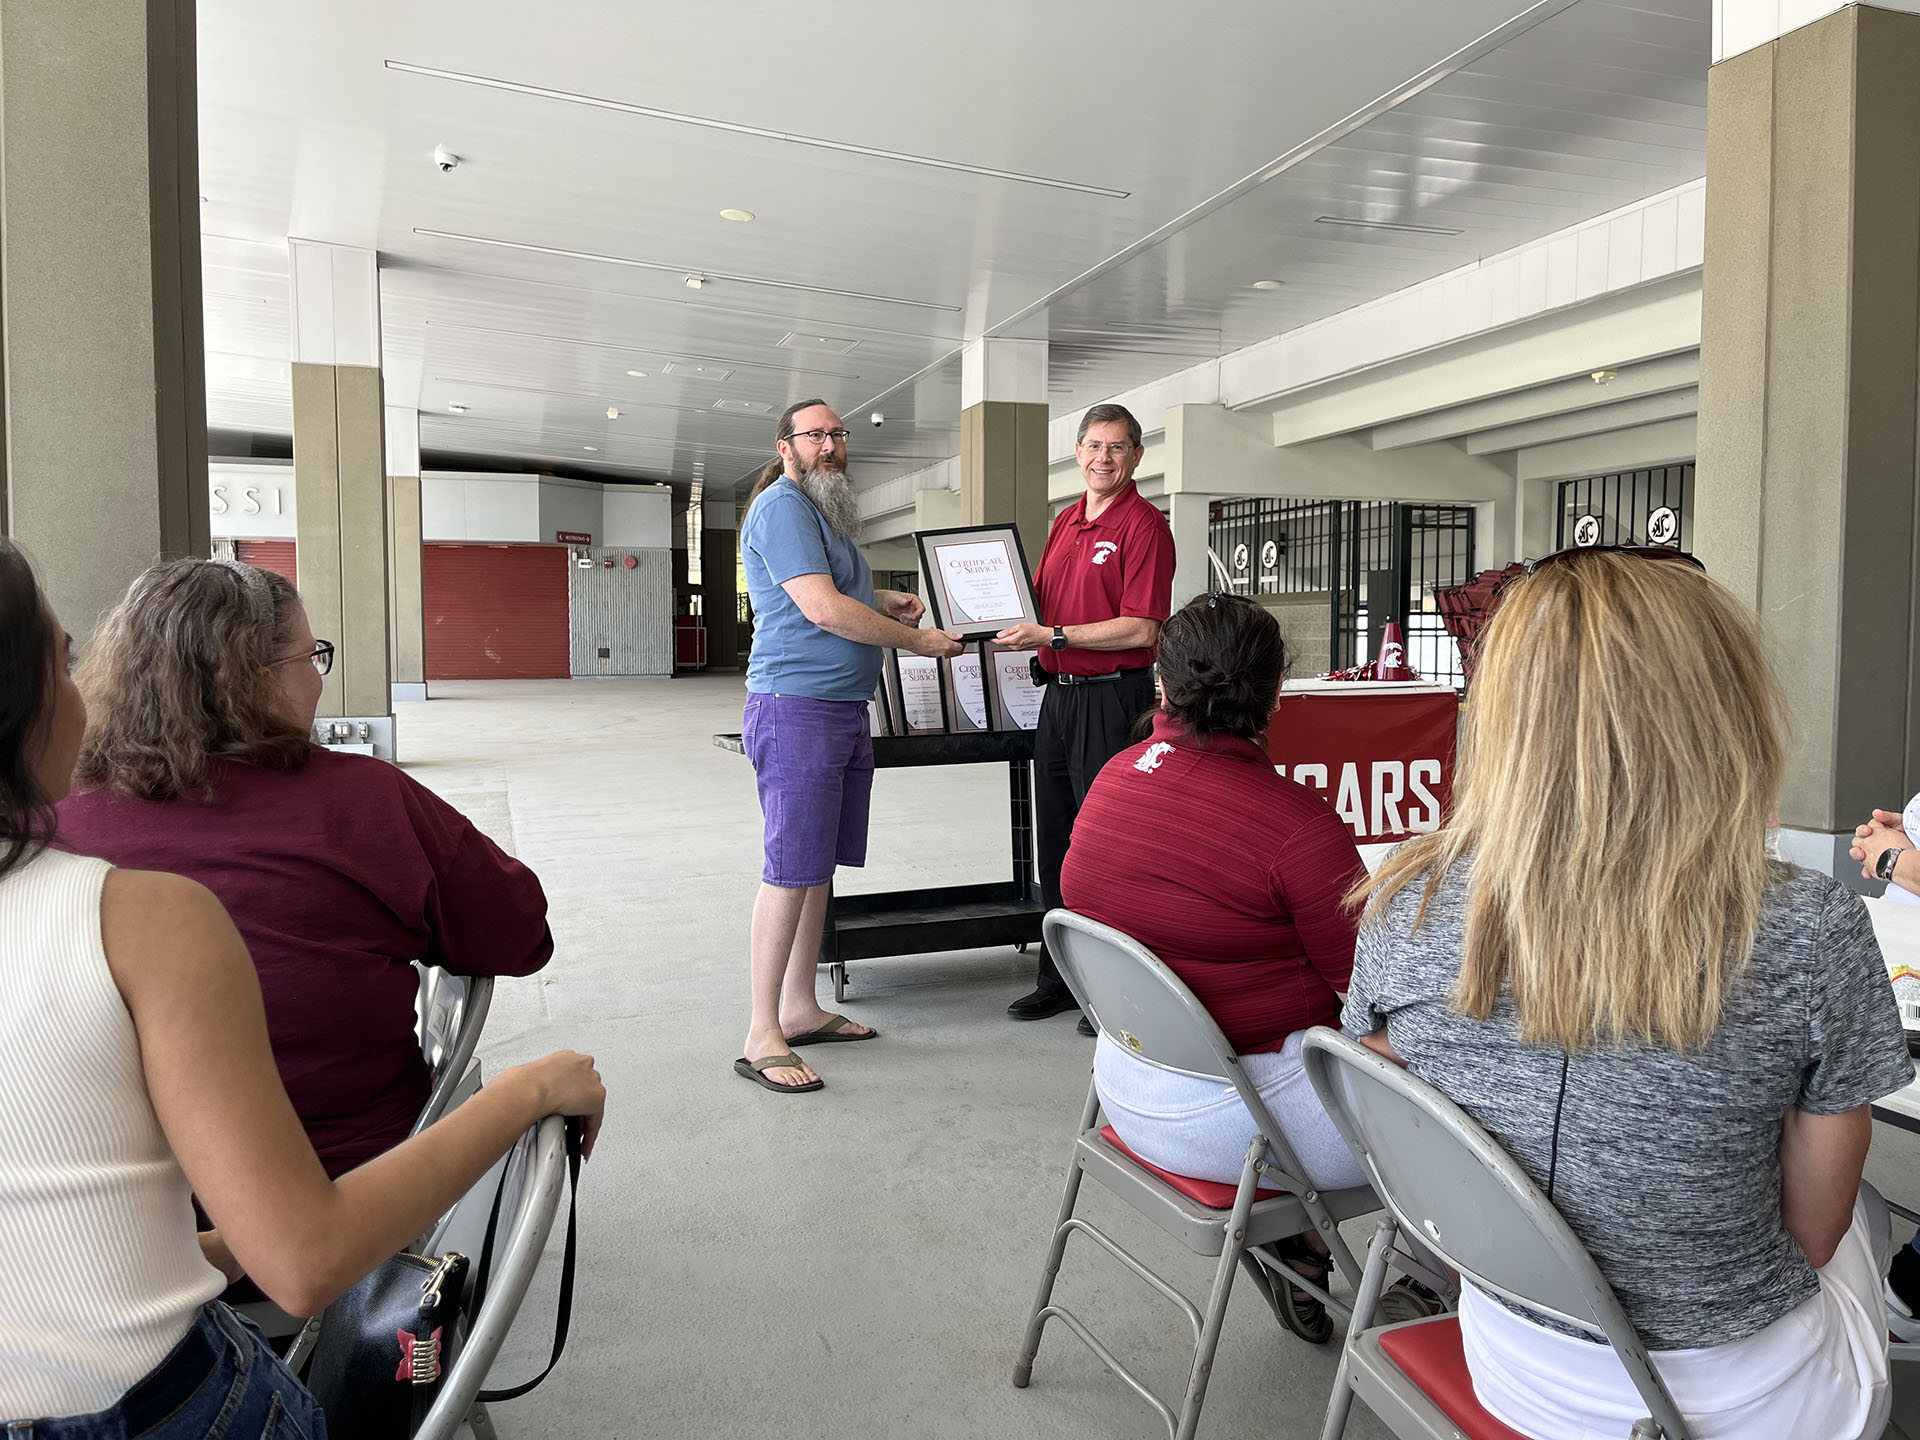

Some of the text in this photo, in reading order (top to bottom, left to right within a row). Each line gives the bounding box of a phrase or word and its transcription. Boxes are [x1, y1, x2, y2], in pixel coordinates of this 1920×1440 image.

[949, 557, 1005, 569] CERTIFICATE
[964, 565, 1000, 574] SERVICE
[908, 674, 938, 682] SERVICE
[1274, 759, 1441, 836] ARS
